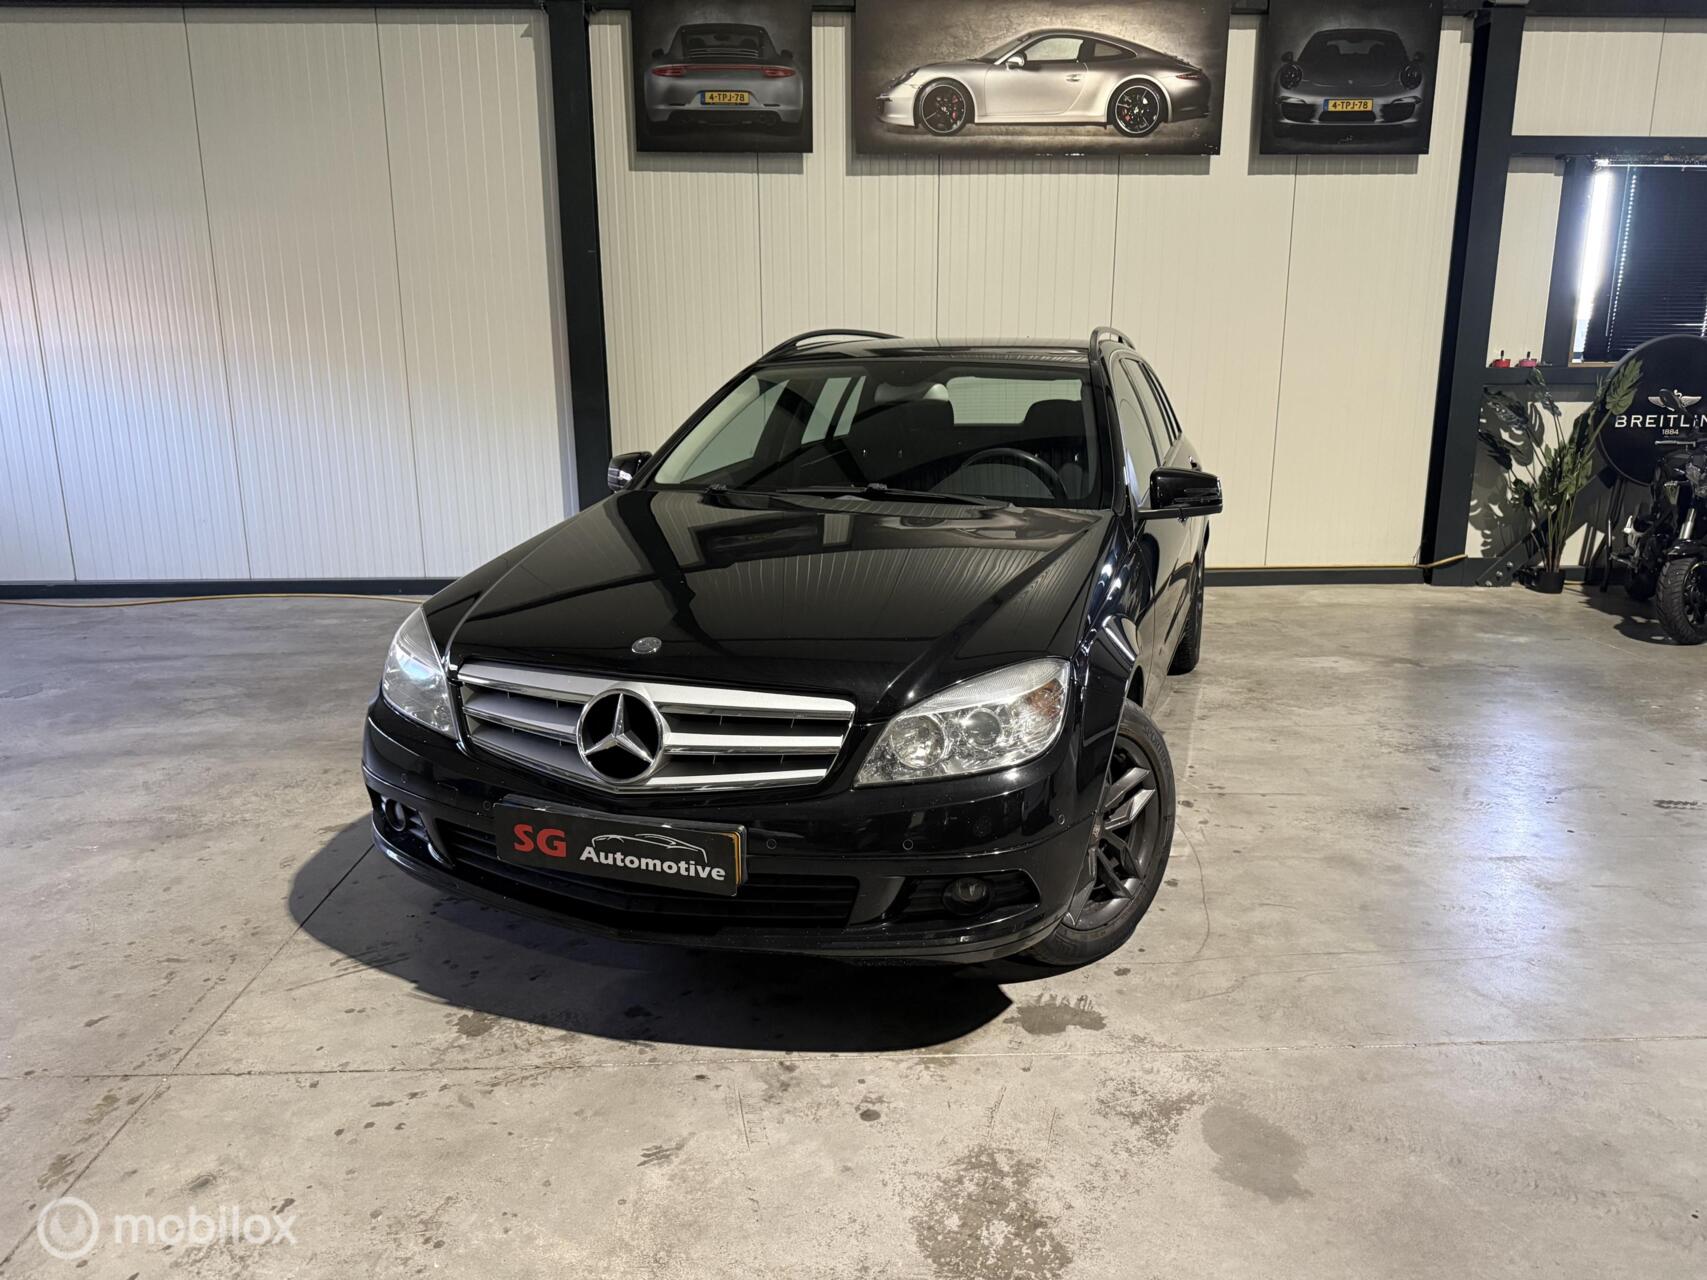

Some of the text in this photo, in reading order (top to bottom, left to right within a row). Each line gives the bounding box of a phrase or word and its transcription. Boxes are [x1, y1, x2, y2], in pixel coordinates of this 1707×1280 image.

[709, 93, 745, 102] 4-TPJ-78
[1332, 100, 1369, 110] 4-TPJ-78
[1661, 428, 1679, 436] 1884
[513, 823, 726, 881] SG Automotive
